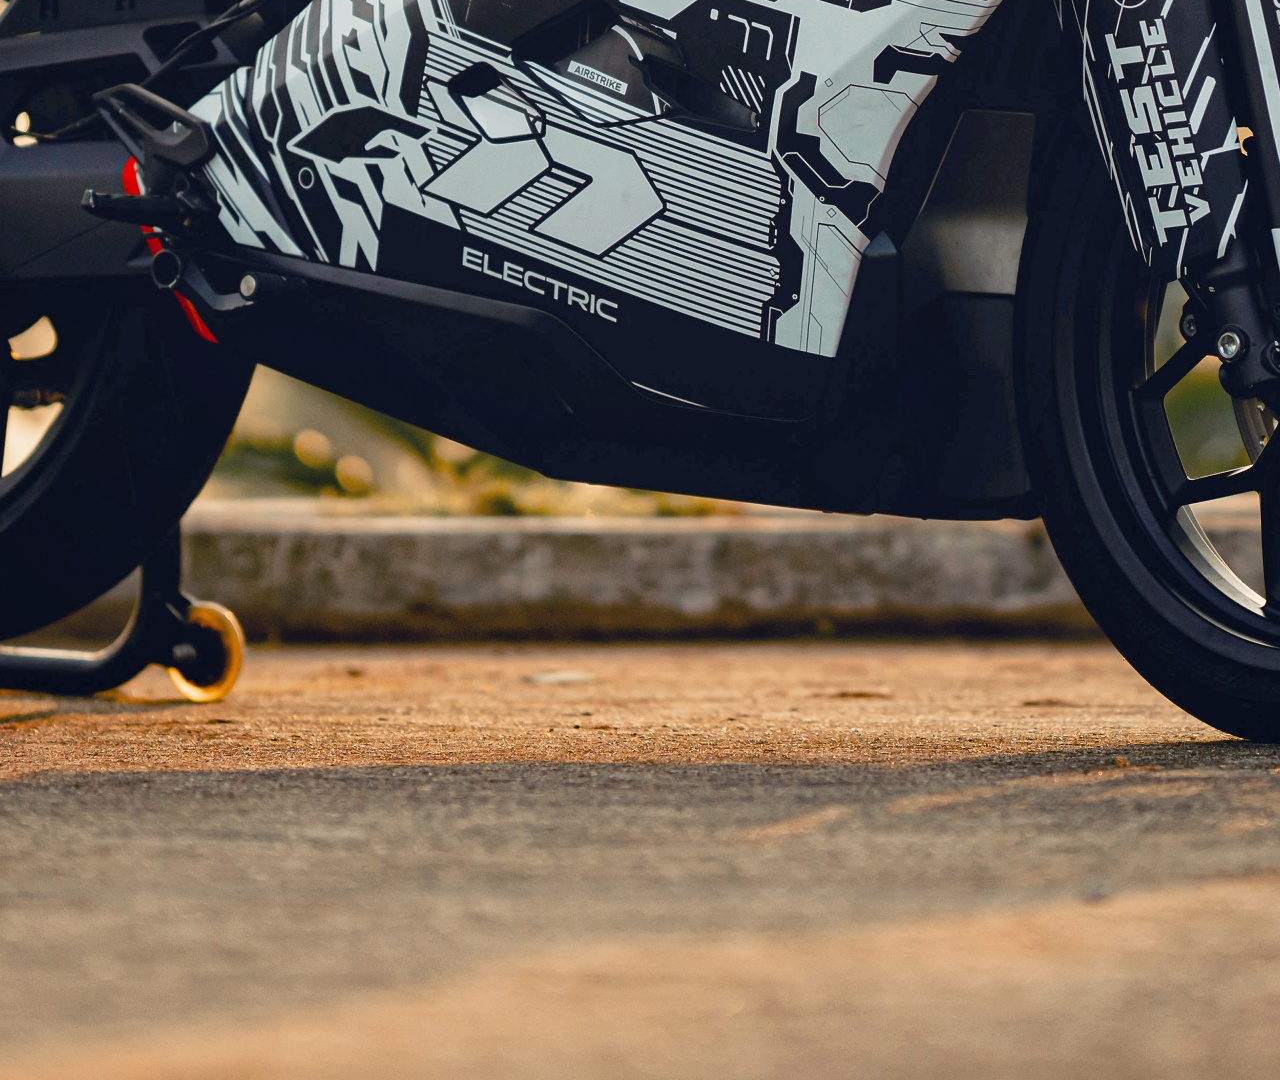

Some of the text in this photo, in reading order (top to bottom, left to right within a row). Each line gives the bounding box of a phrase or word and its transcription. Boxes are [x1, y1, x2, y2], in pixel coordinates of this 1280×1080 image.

[574, 65, 622, 91] AIRSTRIKE
[1104, 33, 1188, 247] TEST
[1139, 18, 1211, 226] VEHICLE
[462, 246, 618, 323] ELECTRIC
